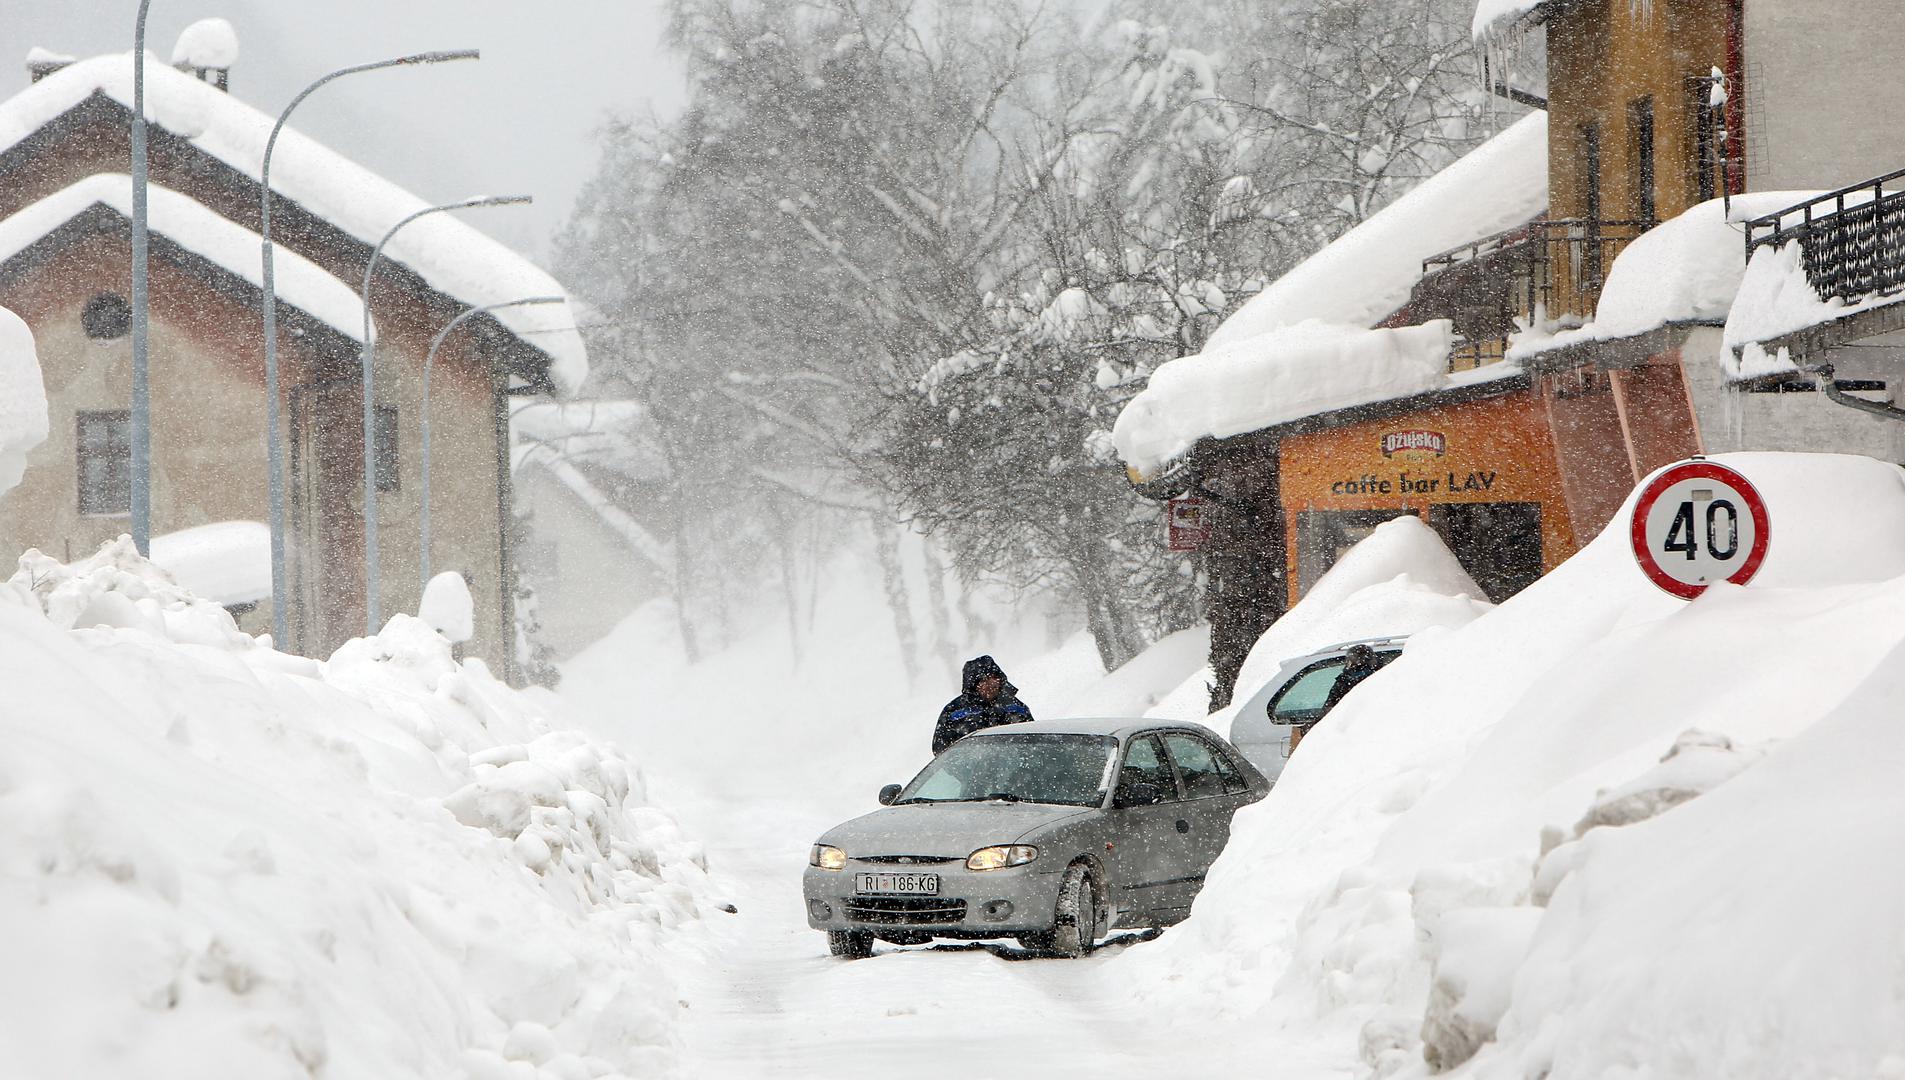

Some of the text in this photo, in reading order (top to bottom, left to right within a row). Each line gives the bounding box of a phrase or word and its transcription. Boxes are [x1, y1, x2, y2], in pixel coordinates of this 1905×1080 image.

[1400, 473, 1440, 493] bar
[1449, 471, 1498, 493] LAV
[1664, 500, 1738, 560] 40
[865, 876, 935, 891] RI 186-KG
